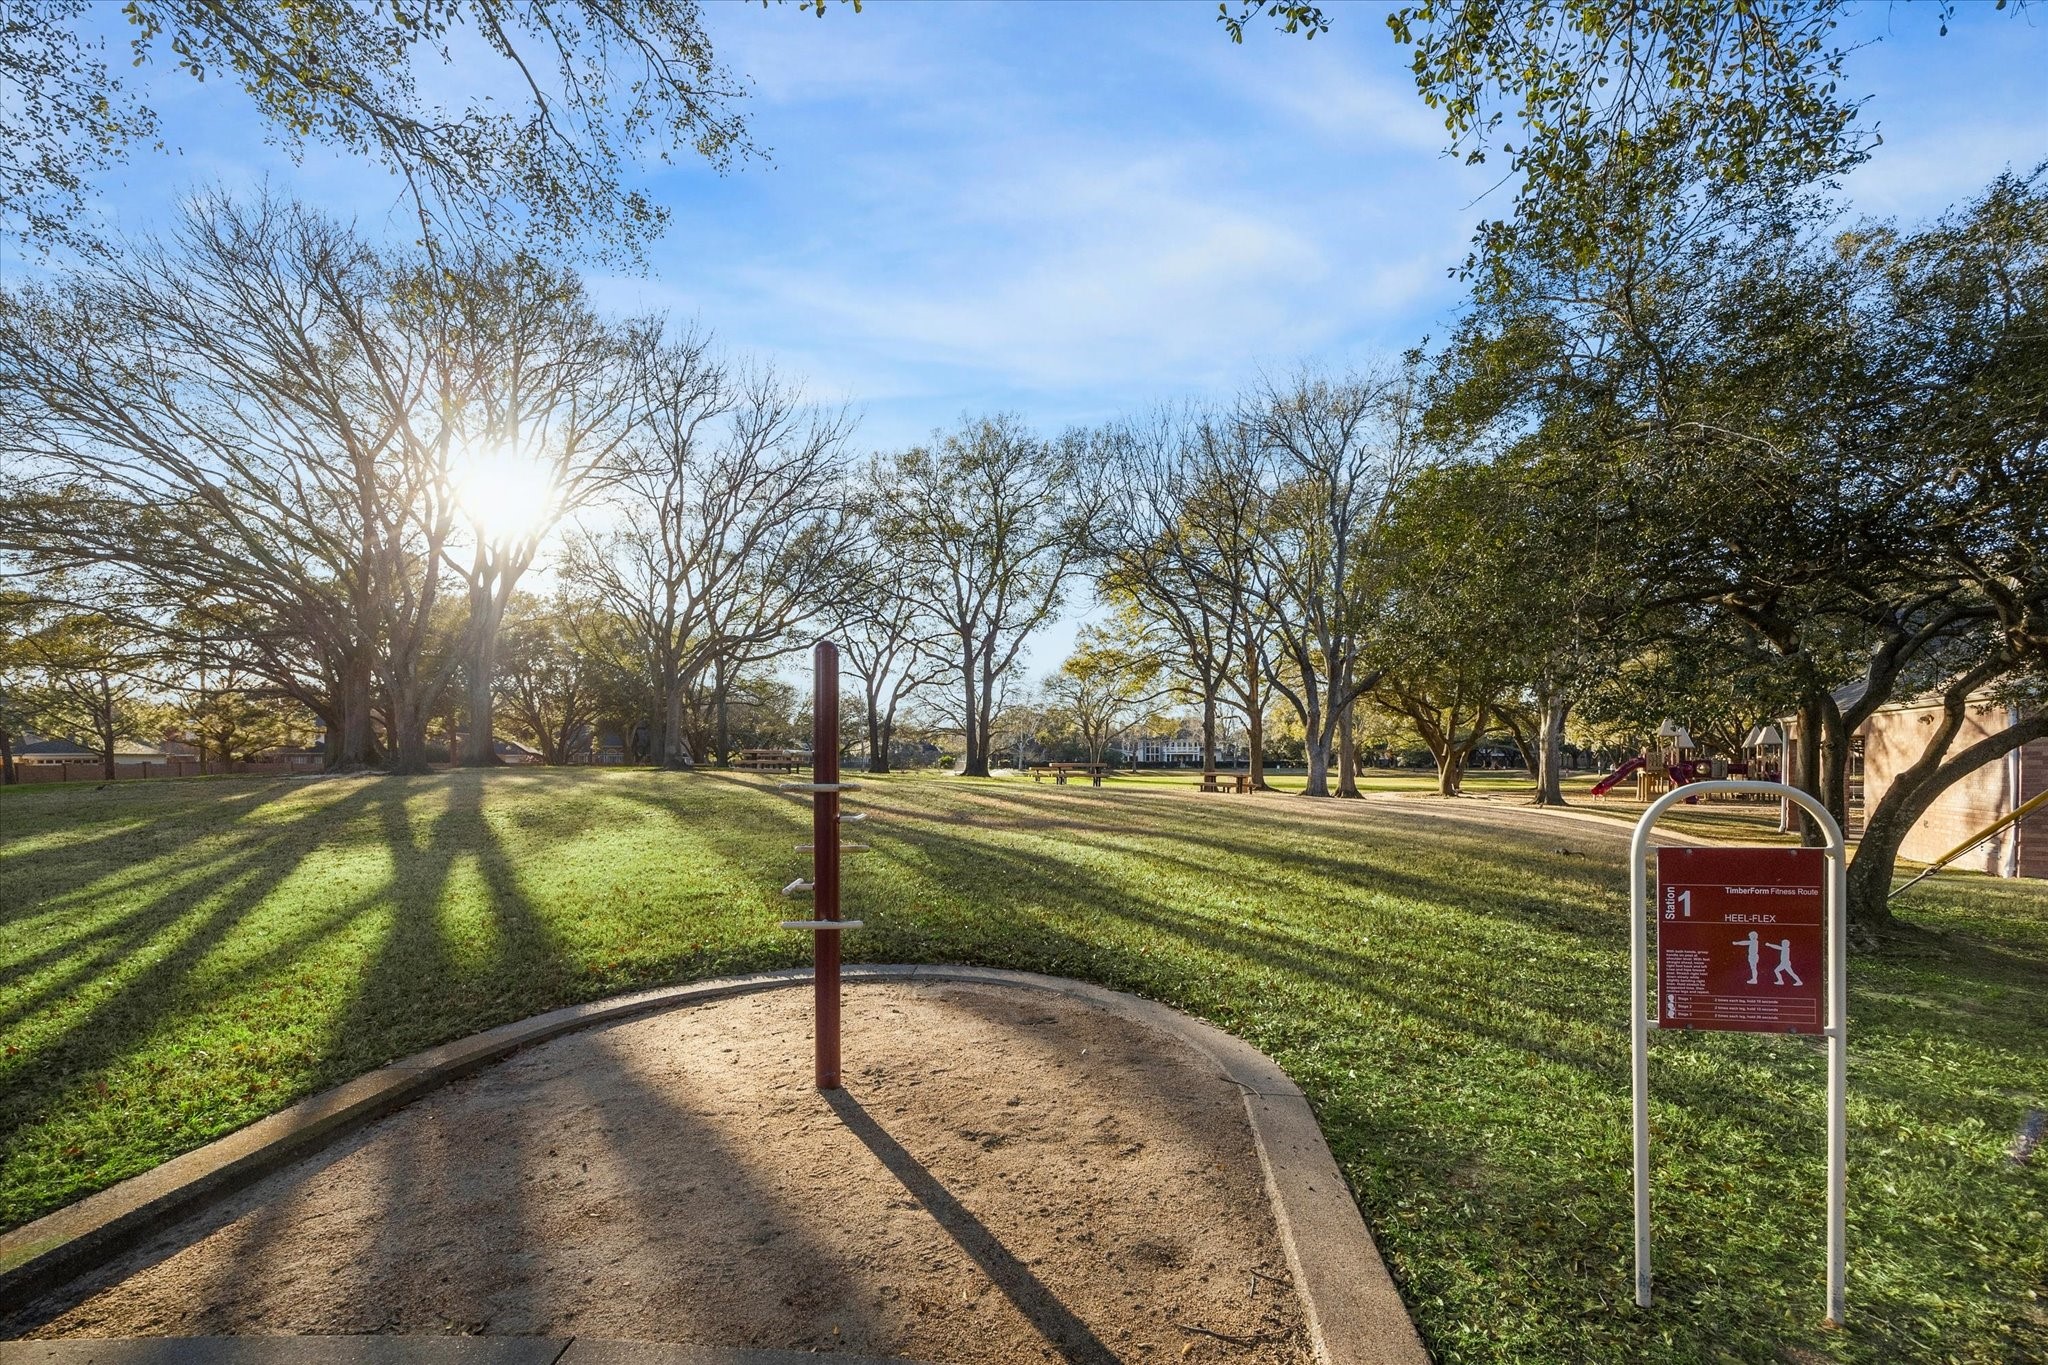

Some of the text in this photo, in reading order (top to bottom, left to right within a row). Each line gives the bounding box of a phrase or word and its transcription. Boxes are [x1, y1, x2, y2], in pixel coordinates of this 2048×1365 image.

[1725, 887, 1770, 895] TimberForm
[1798, 888, 1819, 896] Route
[1665, 886, 1676, 920] Station
[1678, 890, 1691, 917] 1
[1725, 914, 1776, 923] HEEL-FLEX
